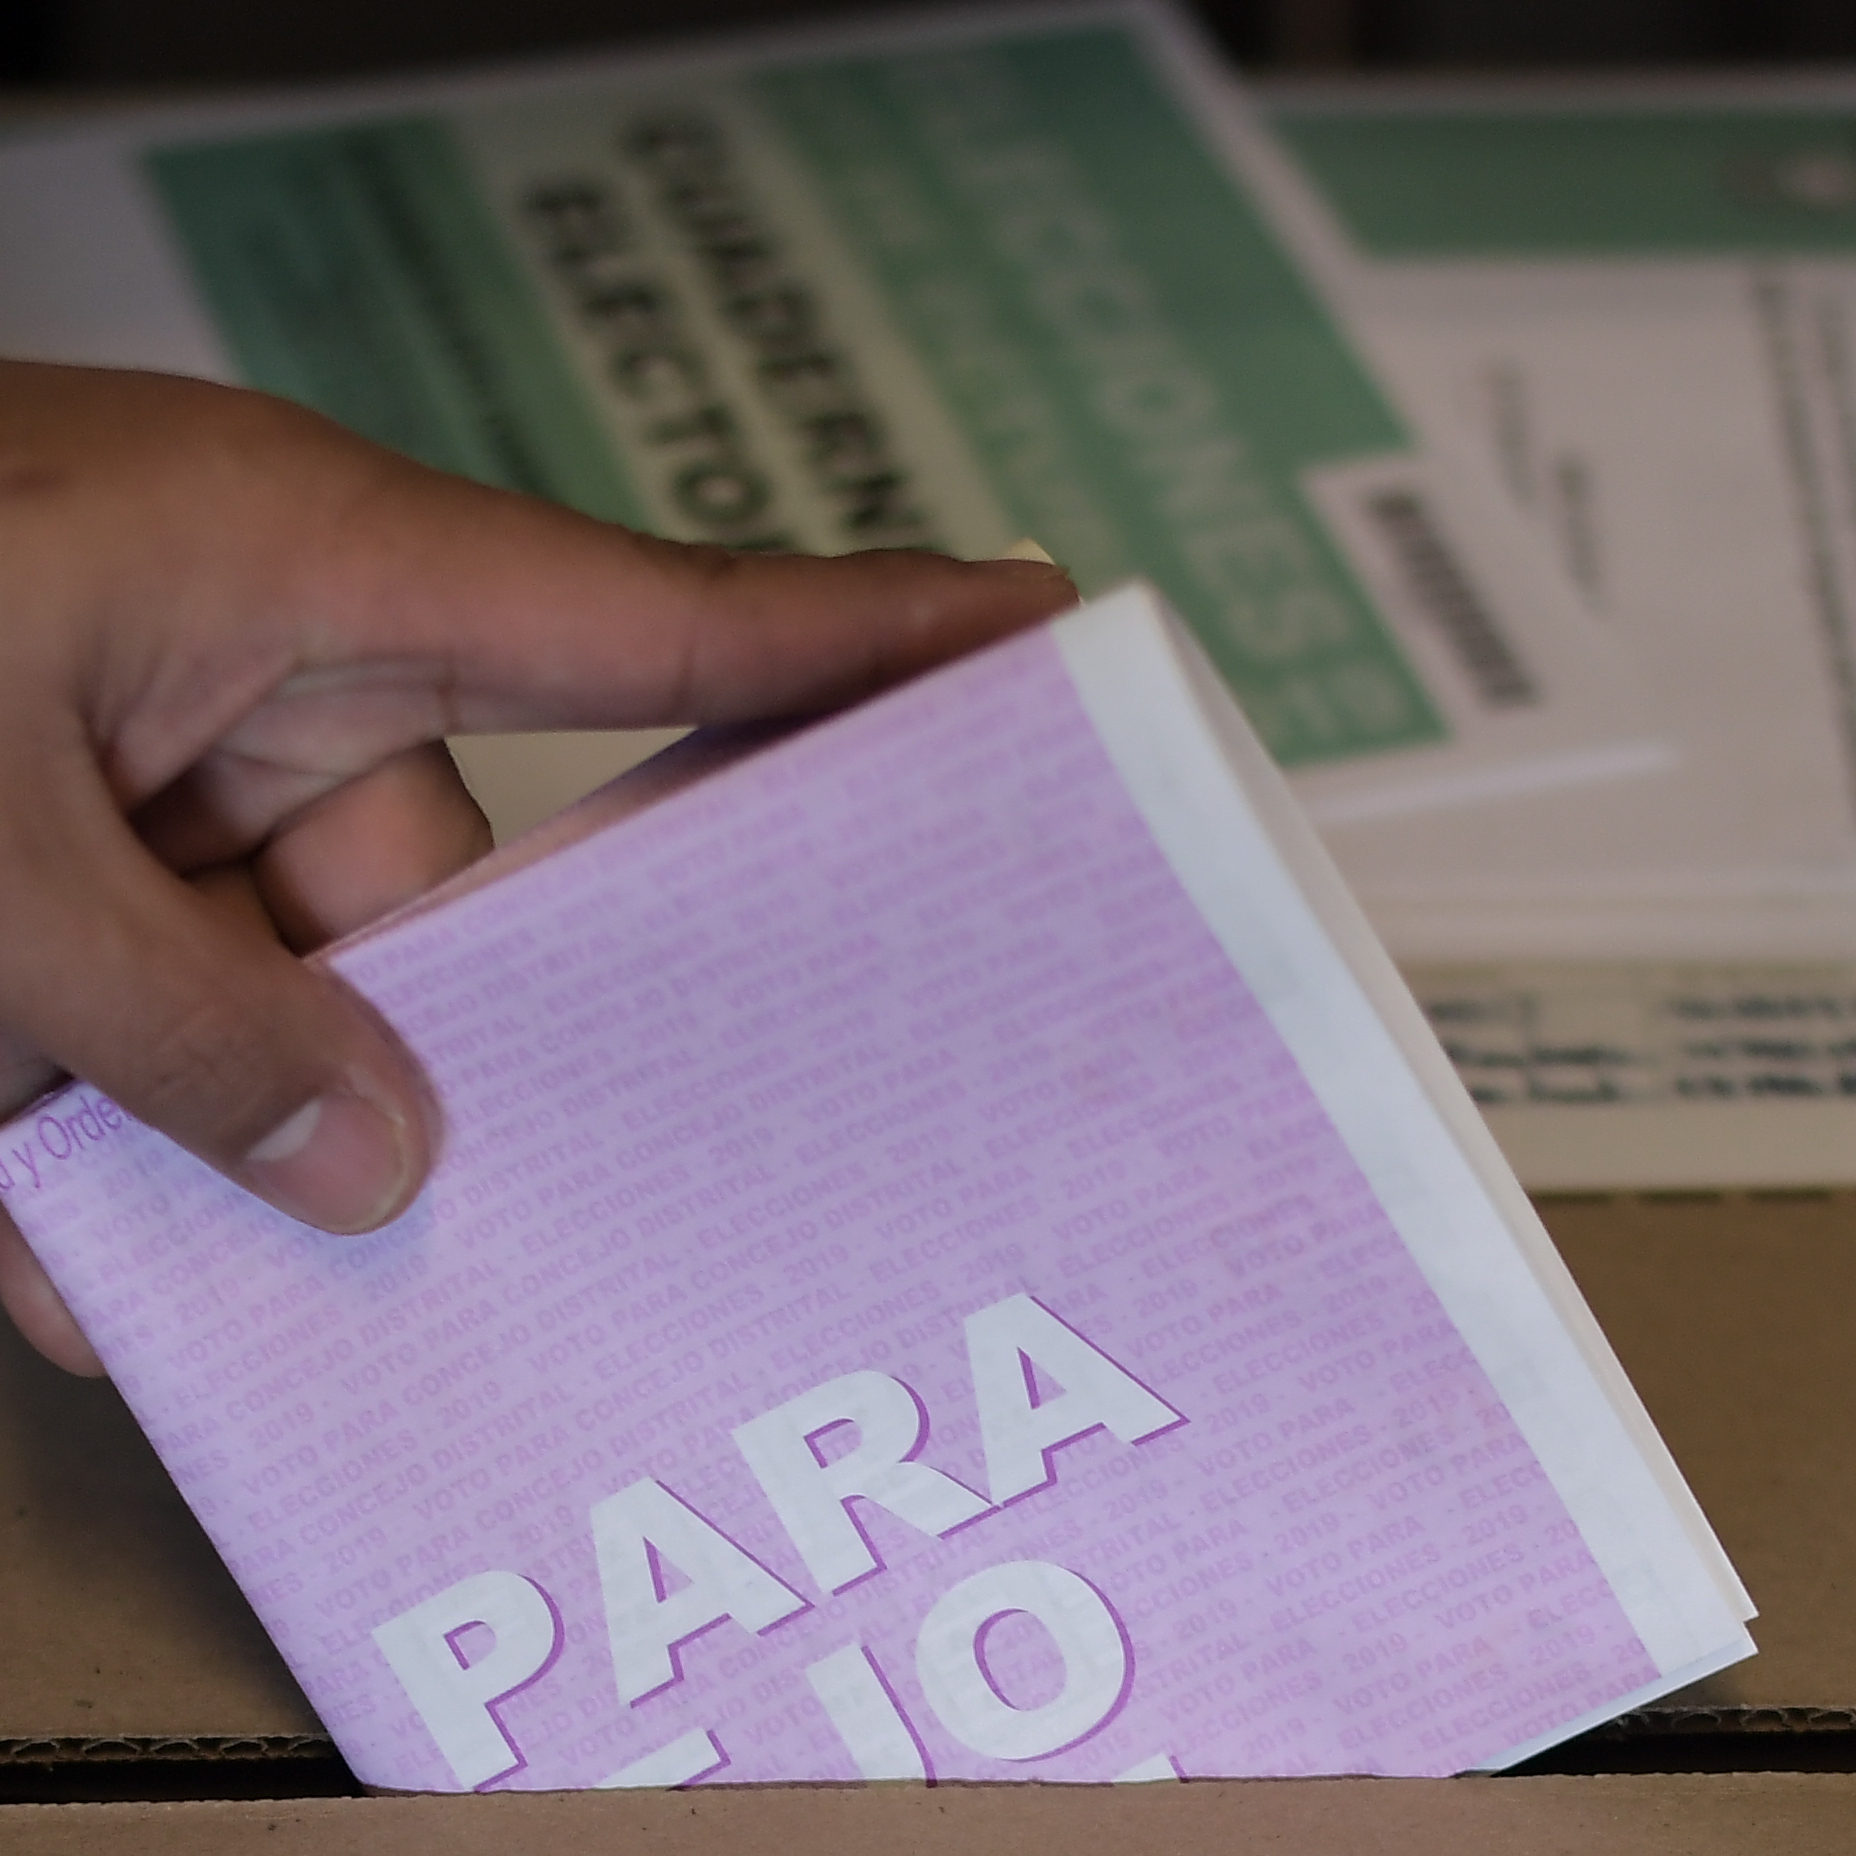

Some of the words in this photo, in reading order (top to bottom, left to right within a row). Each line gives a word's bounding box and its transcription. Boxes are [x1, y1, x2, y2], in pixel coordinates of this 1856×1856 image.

[525, 172, 799, 556] ELECTO
[620, 104, 950, 555] CUADERN
[458, 1040, 539, 1093] PARA
[15, 1139, 44, 1189] y
[36, 1098, 130, 1162] Orde
[163, 1313, 248, 1373] VOTO
[245, 1267, 327, 1328] PARA
[459, 1124, 605, 1210] DISTRITAL
[168, 1298, 347, 1412] ELECCIONES
[358, 1250, 432, 1306] 2019
[453, 1195, 537, 1253] VOTO
[533, 1158, 614, 1212] PARA
[610, 1098, 747, 1175] CONCEJO
[743, 1036, 892, 1116] DISTRITAL
[219, 1333, 358, 1426] CONCEJO
[355, 1251, 506, 1349] DISTRITAL
[517, 1160, 693, 1260] ELECCIONES
[705, 1123, 778, 1170] 2019
[797, 1078, 881, 1129] VOTO
[878, 1044, 961, 1095] PARA
[237, 1438, 322, 1498] VOTO
[319, 1392, 401, 1454] PARA
[396, 1317, 534, 1409] CONCEJO
[530, 1243, 681, 1334] DISTRITAL
[694, 1157, 870, 1252] ELECCIONES
[881, 1120, 956, 1168] 2019
[974, 1076, 1062, 1128] VOTO
[244, 1398, 319, 1453] 2019
[338, 1338, 423, 1400] VOTO
[419, 1294, 502, 1354] PARA
[497, 1225, 636, 1311] CONCEJO
[634, 1159, 779, 1241] DISTRITAL
[792, 1077, 971, 1169] ELECCIONES
[1130, 1274, 1203, 1321] 2019
[1222, 1229, 1308, 1281] VOTO
[1137, 1188, 1318, 1281] ELECCIONES
[1316, 1268, 1389, 1314] 2019
[170, 1273, 244, 1328] 2019
[243, 1423, 421, 1536] ELECCIONES
[431, 1374, 506, 1431] 2019
[524, 1317, 610, 1378] VOTO
[607, 1278, 689, 1334] PARA
[685, 1216, 822, 1294] CONCEJO
[819, 1152, 968, 1232] DISTRITAL
[294, 1459, 432, 1550] CONCEJO
[428, 1376, 576, 1475] DISTRITAL
[589, 1279, 767, 1384] ELECCIONES
[779, 1240, 853, 1288] 2019
[874, 1194, 957, 1246] VOTO
[954, 1160, 1037, 1211] PARA
[319, 1524, 392, 1578] 2019
[411, 1464, 496, 1527] VOTO
[492, 1419, 574, 1480] PARA
[570, 1346, 709, 1435] CONCEJO
[706, 1277, 854, 1363] DISTRITAL
[867, 1194, 1045, 1287] ELECCIONES
[1057, 1157, 1131, 1204] 2019
[1204, 1275, 1286, 1326] PARA
[1210, 1305, 1388, 1398] ELECCIONES
[311, 1563, 396, 1621] VOTO
[392, 1519, 474, 1580] PARA
[470, 1442, 606, 1535] CONCEJO
[603, 1364, 752, 1458] DISTRITAL
[766, 1275, 943, 1372] ELECCIONES
[955, 1238, 1029, 1285] 2019
[1048, 1192, 1134, 1245] VOTO
[1131, 1158, 1214, 1210] PARA
[506, 1501, 577, 1556] 2019
[1054, 1187, 1233, 1280] ELECCIONES
[1010, 1430, 1189, 1527] ELECCIONES
[1203, 1391, 1276, 1439] 2019
[1296, 1345, 1381, 1398] VOTO
[1099, 1475, 1172, 1523] 2019
[1194, 1428, 1278, 1480] VOTO
[1275, 1392, 1358, 1444] PARA
[1168, 1514, 1252, 1567] PARA
[1279, 1422, 1459, 1517] ELECCIONES
[1197, 1421, 1377, 1517] ELECCIONES
[1390, 1383, 1463, 1431] 2019
[1272, 1510, 1345, 1558] 2019
[1365, 1463, 1451, 1516] VOTO
[371, 1292, 1189, 1791] PARA
[1168, 1594, 1243, 1643] 2019
[1262, 1547, 1347, 1600] VOTO
[1344, 1510, 1427, 1563] PARA
[1266, 1540, 1445, 1636] ELECCIONES
[1458, 1501, 1532, 1549] 2019
[1158, 1670, 1241, 1725] VOTO
[1238, 1634, 1321, 1687] PARA
[1348, 1540, 1528, 1636] ELECCIONES
[1331, 1666, 1415, 1719] VOTO
[1412, 1630, 1494, 1682] PARA
[1334, 1659, 1512, 1755] ELECCIONES
[1525, 1621, 1600, 1669] 2019
[1340, 1629, 1412, 1678] 2019
[1433, 1582, 1518, 1635] VOTO
[1415, 1660, 1595, 1756] ELECCIONES
